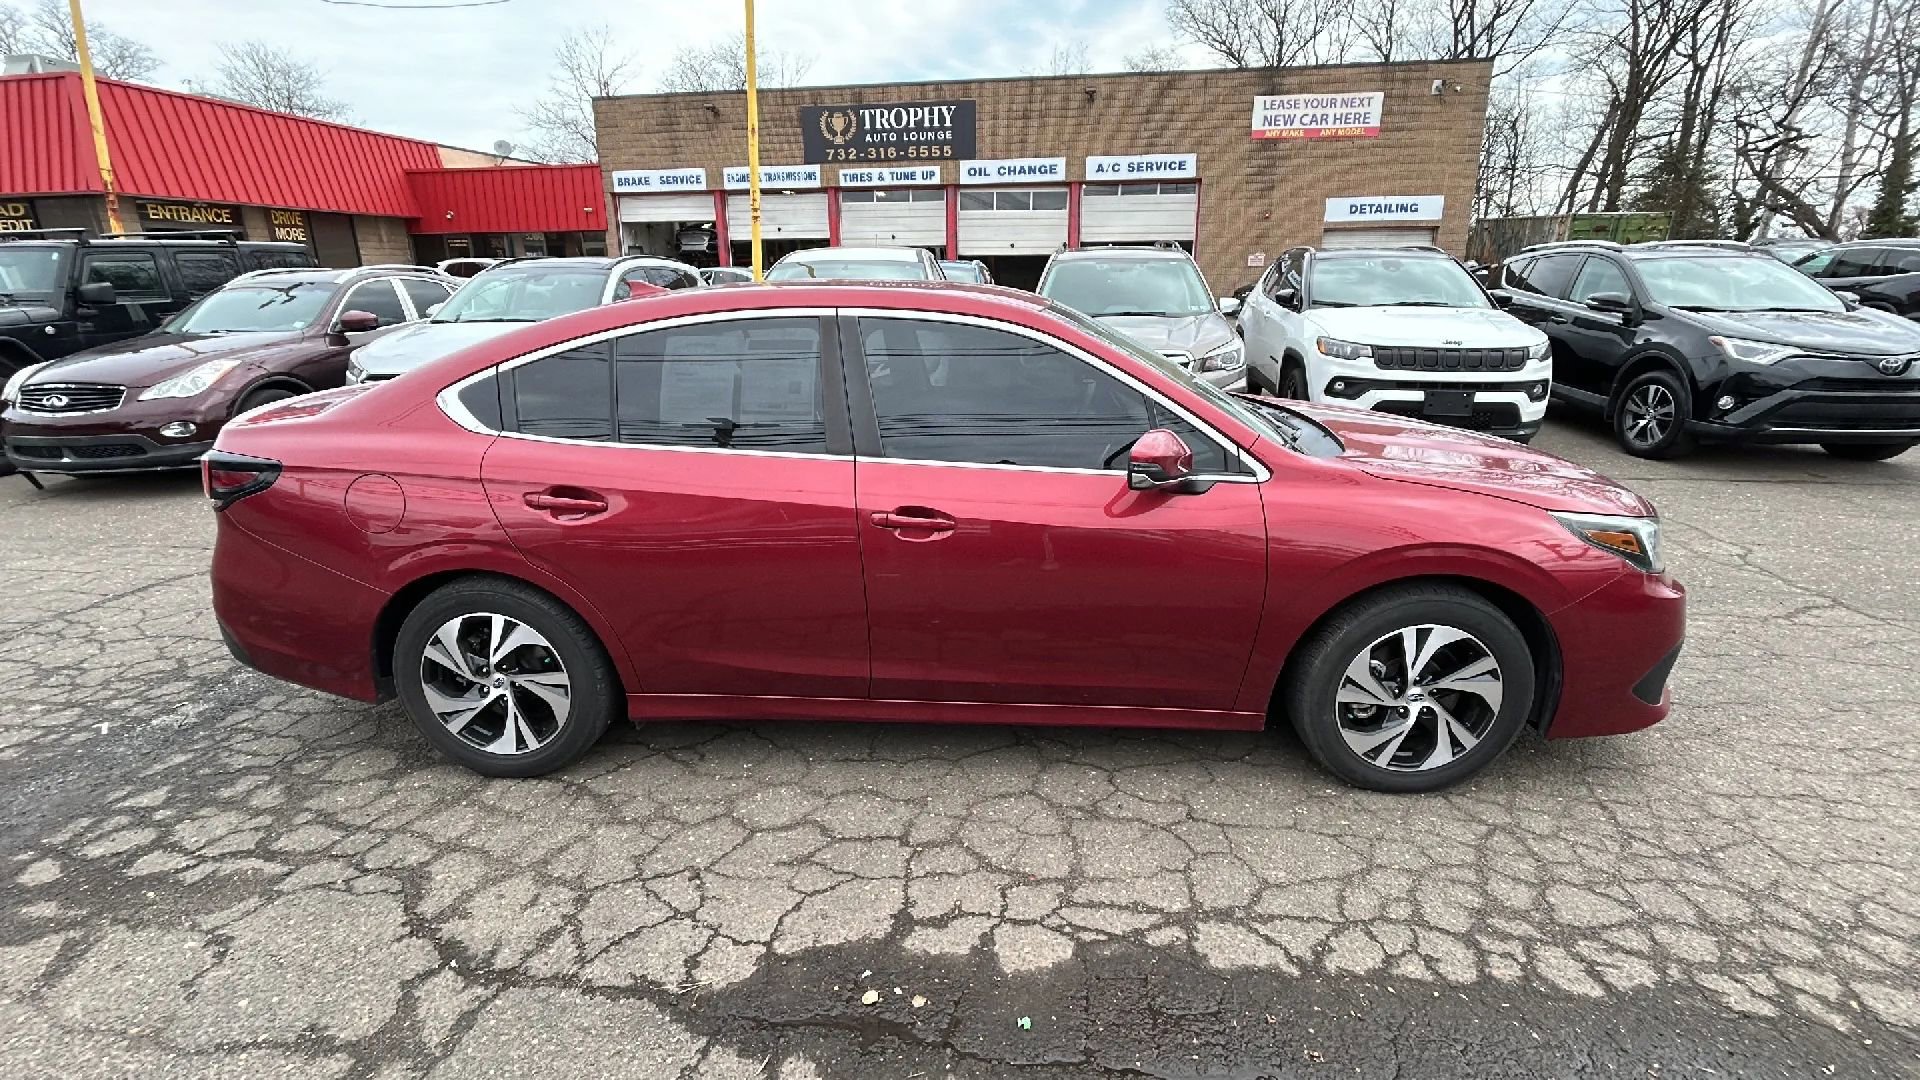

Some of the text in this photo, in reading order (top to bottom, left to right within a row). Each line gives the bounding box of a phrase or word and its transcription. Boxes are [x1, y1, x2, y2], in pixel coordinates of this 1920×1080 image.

[1263, 96, 1374, 110] LEASE YOUR NEXT
[860, 105, 956, 129] TROPHY
[1263, 112, 1371, 127] NEW CAR HERE
[865, 130, 953, 143] AUTO LOUNGE
[1264, 129, 1304, 137] ANY MAKE
[1319, 127, 1366, 136] ANY MODEL
[825, 146, 952, 160] 732-316-5555
[967, 163, 1058, 177] OIL CHANGE
[1096, 160, 1187, 173] A/C SERVICE
[617, 174, 702, 187] BRAKE SERVICE
[764, 171, 817, 182] TRANSMISSIONS
[842, 170, 936, 183] TIRES & TUNE UP
[146, 203, 233, 223] ENTRANCE
[1349, 203, 1419, 215] DETAILING
[270, 209, 304, 226] DRIVE
[275, 227, 307, 241] MORE
